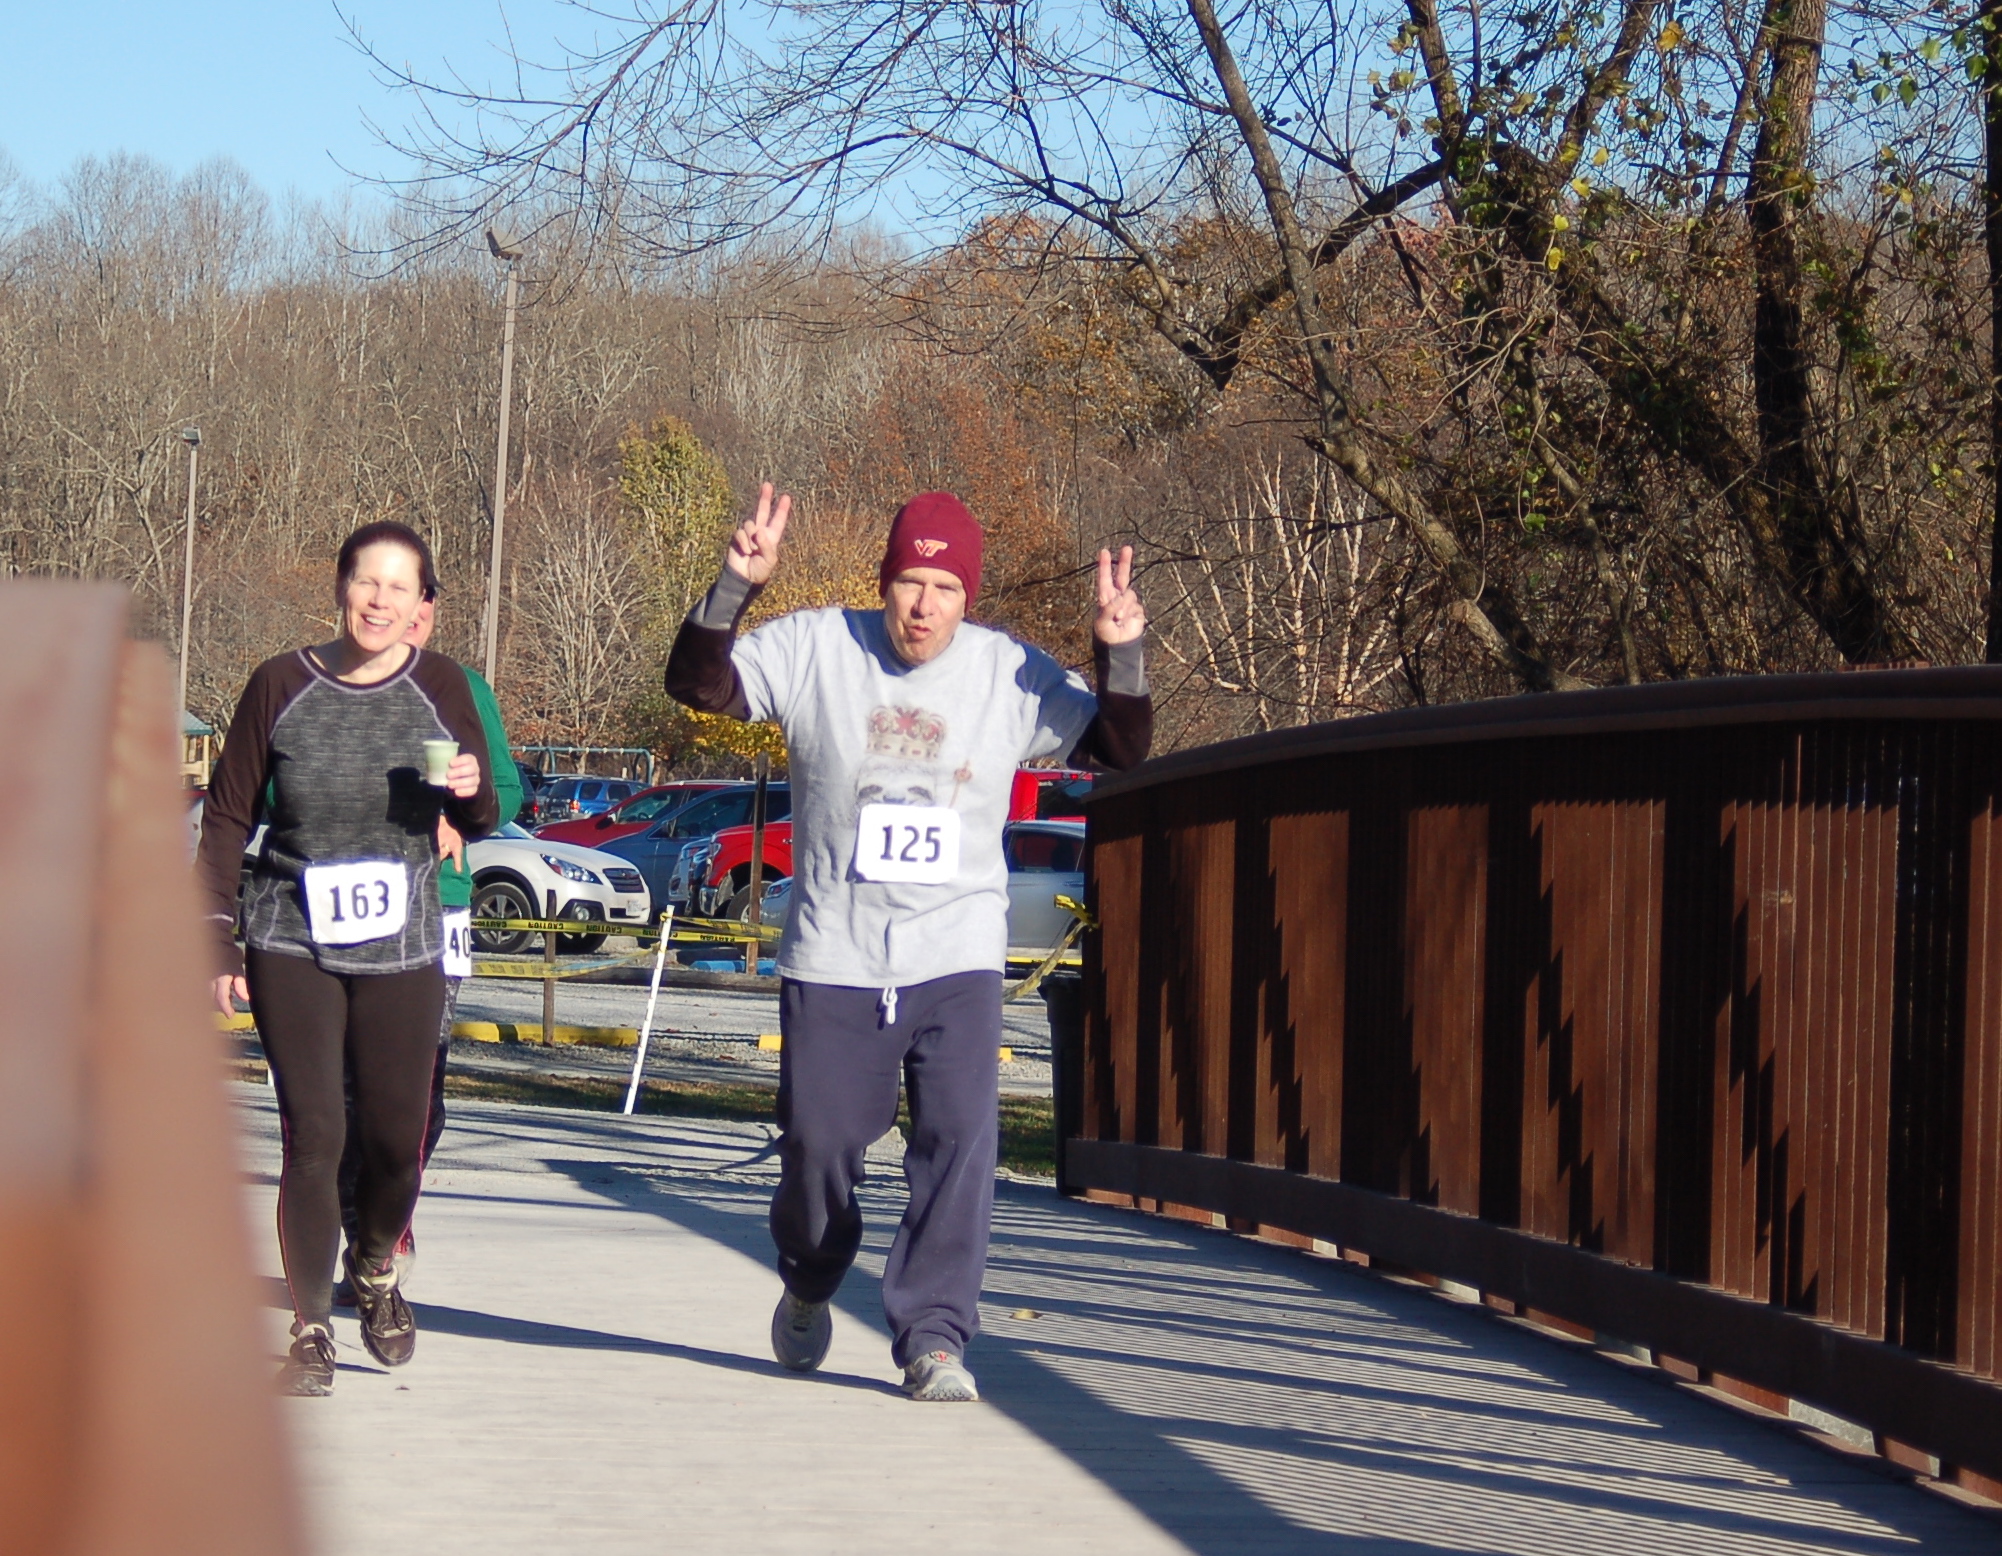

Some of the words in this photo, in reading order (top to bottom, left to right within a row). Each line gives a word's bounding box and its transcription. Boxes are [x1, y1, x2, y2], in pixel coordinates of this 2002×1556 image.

[914, 539, 948, 557] VT
[880, 824, 941, 863] 125
[329, 879, 390, 922] 163
[528, 921, 564, 930] CAUTION
[585, 923, 623, 934] CAUTION
[449, 927, 471, 958] 40
